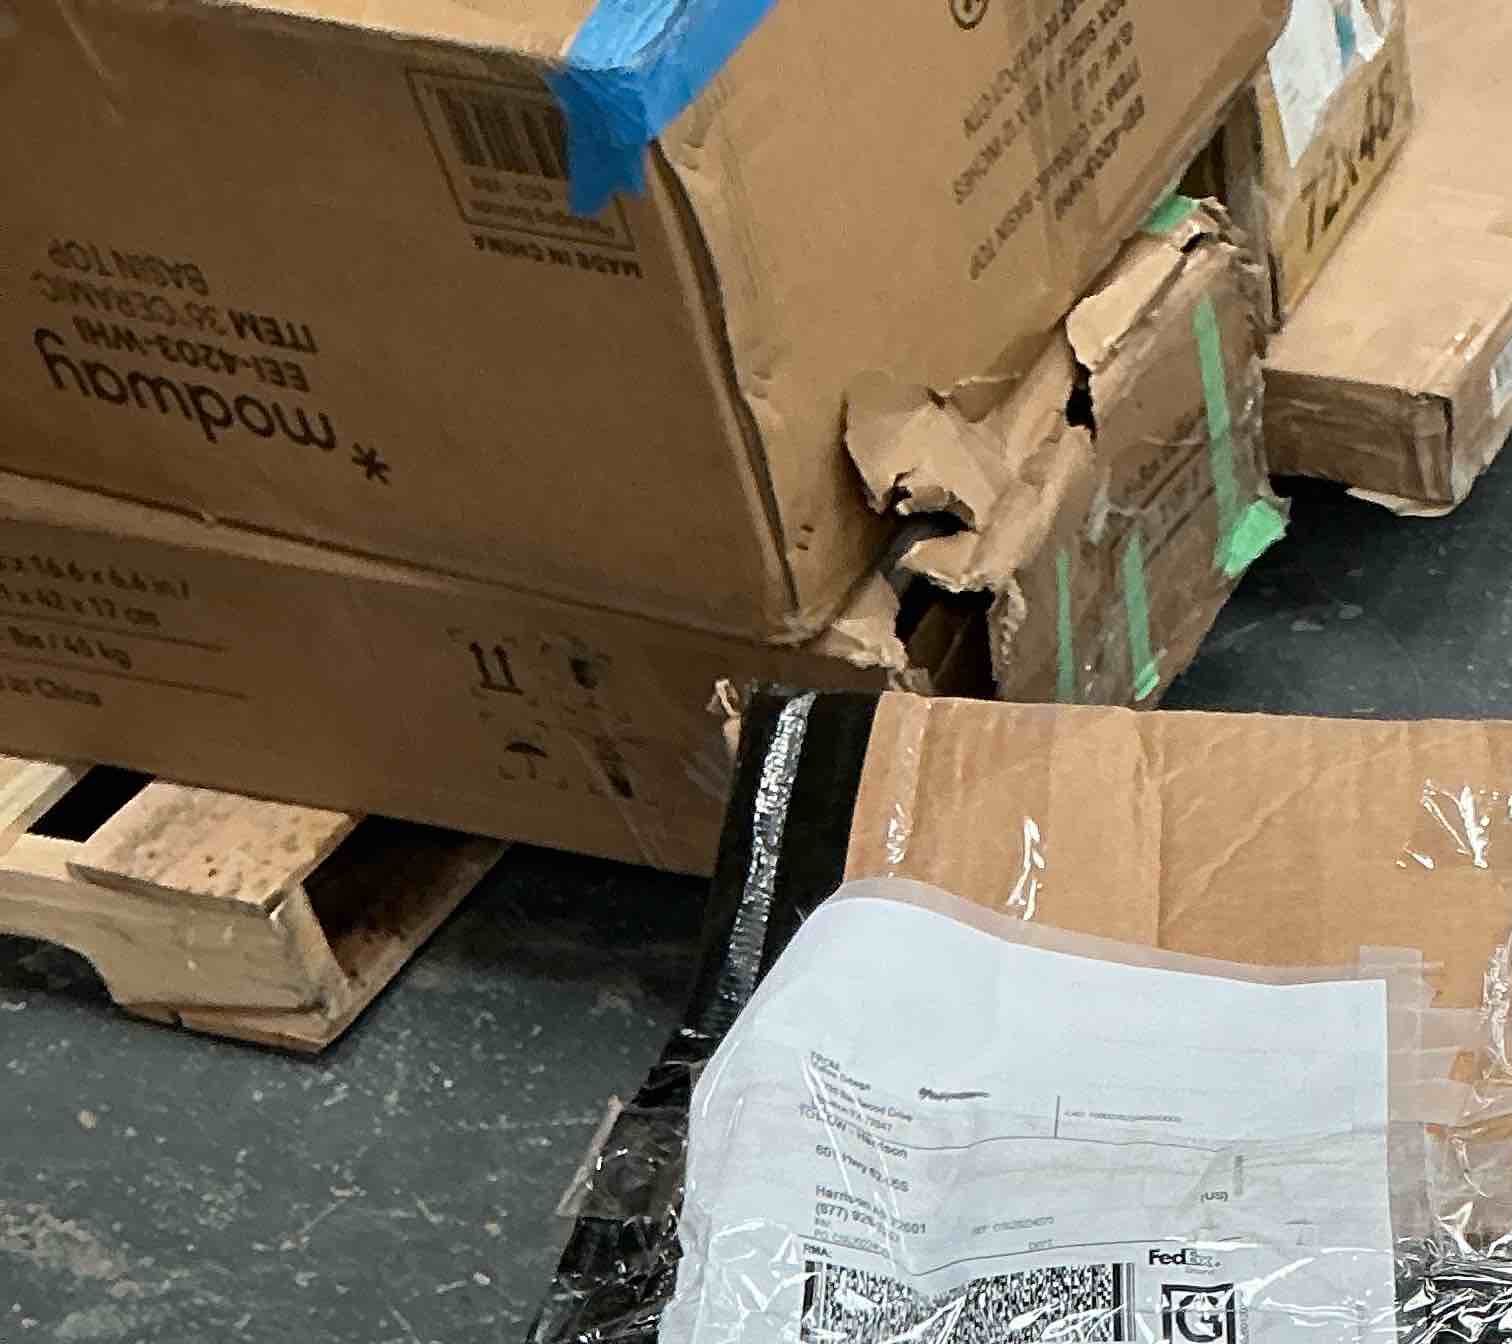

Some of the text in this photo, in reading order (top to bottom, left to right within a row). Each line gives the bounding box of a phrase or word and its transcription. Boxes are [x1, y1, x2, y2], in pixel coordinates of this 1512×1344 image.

[73, 315, 310, 393] EEI-4203-WHI
[228, 308, 319, 354] ITEM
[34, 328, 336, 451] modway
